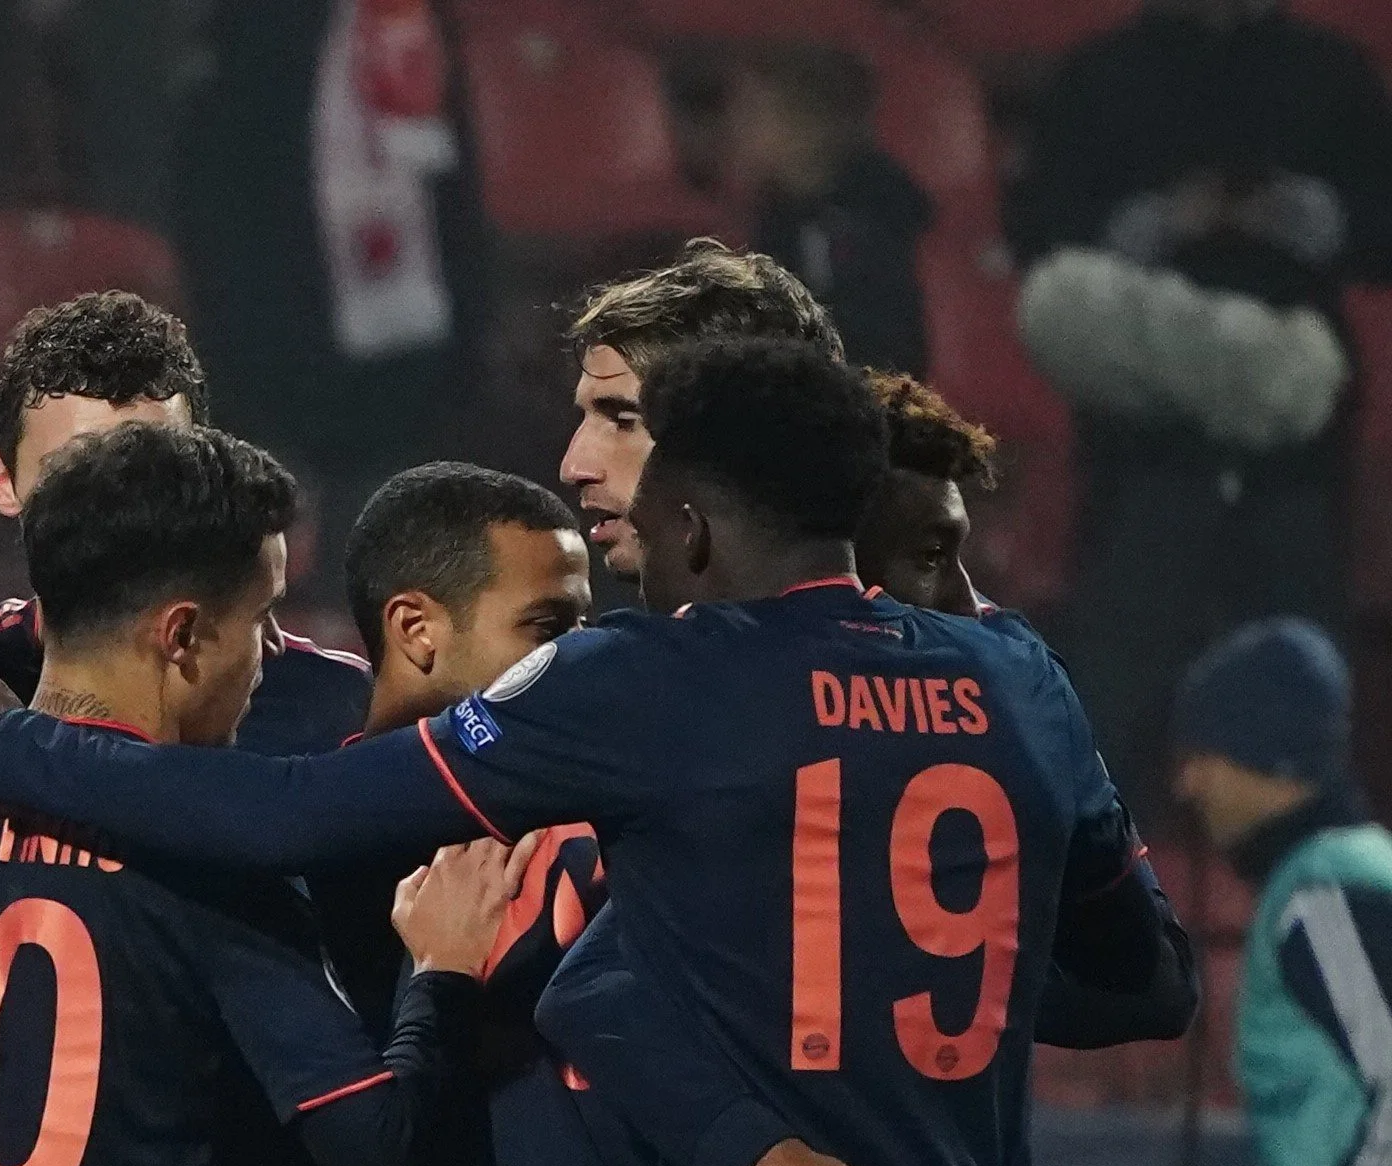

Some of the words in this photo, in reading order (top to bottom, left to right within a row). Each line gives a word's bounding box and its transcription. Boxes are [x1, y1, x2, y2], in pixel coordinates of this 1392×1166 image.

[454, 698, 496, 747] SPECT
[811, 669, 989, 735] DAVIES
[791, 757, 1019, 1081] 19
